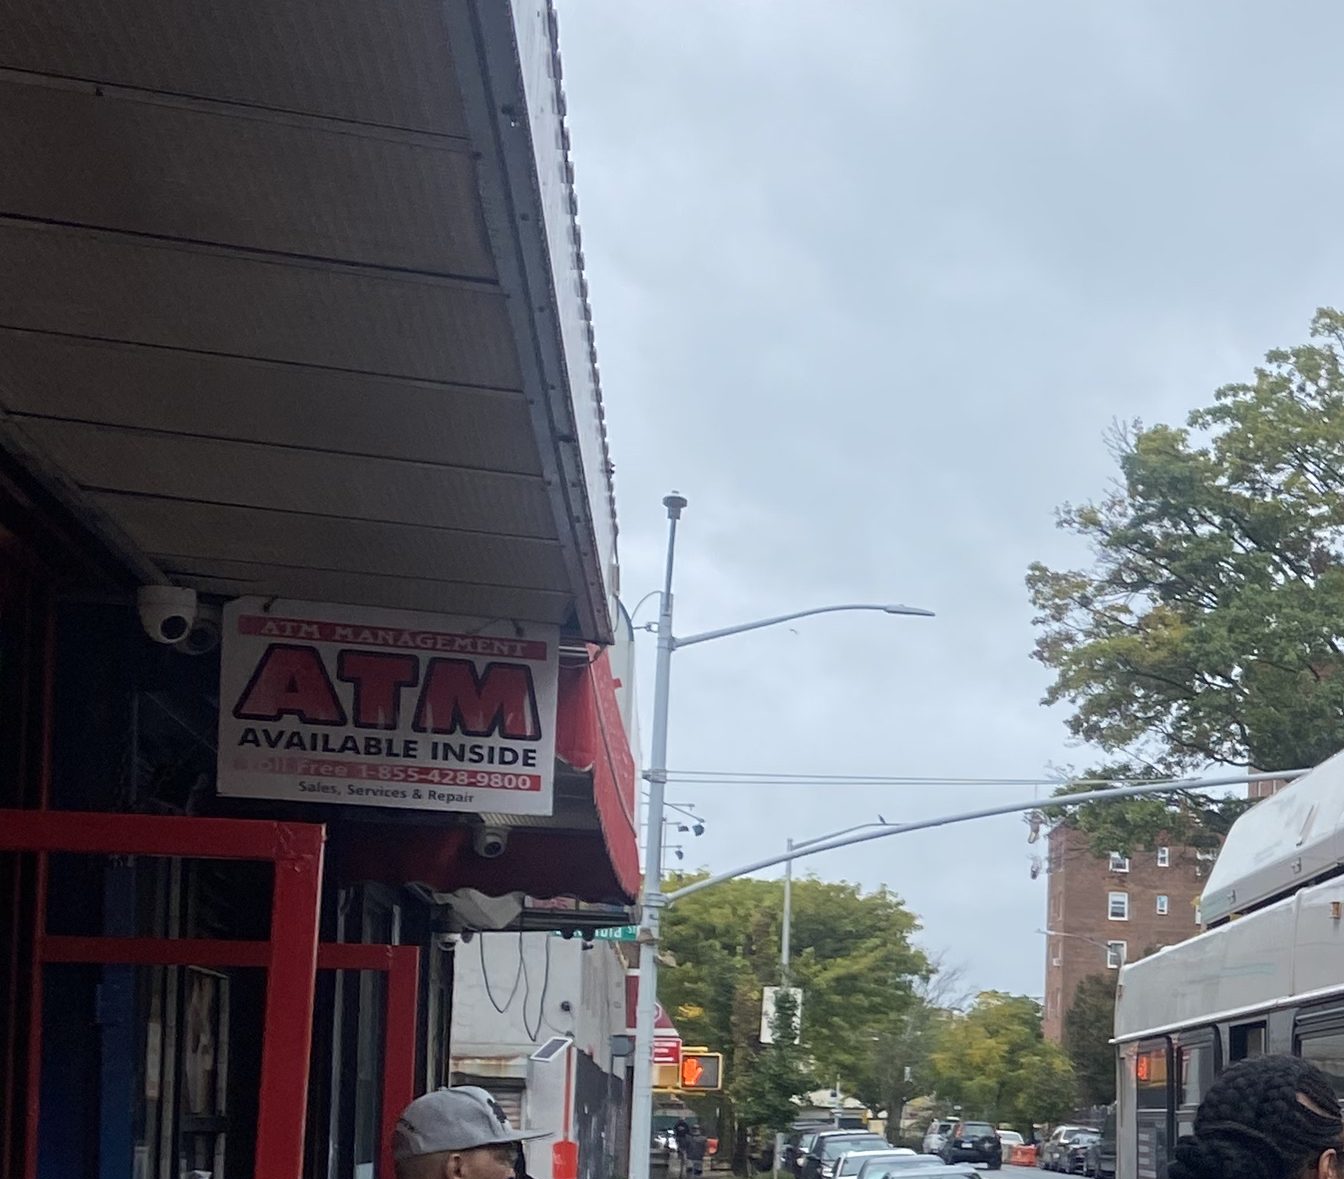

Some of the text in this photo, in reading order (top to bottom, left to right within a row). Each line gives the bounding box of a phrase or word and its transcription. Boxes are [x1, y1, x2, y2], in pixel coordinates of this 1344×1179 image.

[260, 619, 528, 657] ATM MANAGEMENT
[233, 643, 542, 741] ATM
[238, 727, 538, 768] AVAILABLE INSIDE
[298, 780, 474, 804] Sales, Services & Repair
[358, 764, 532, 791] 1-855-428-9800
